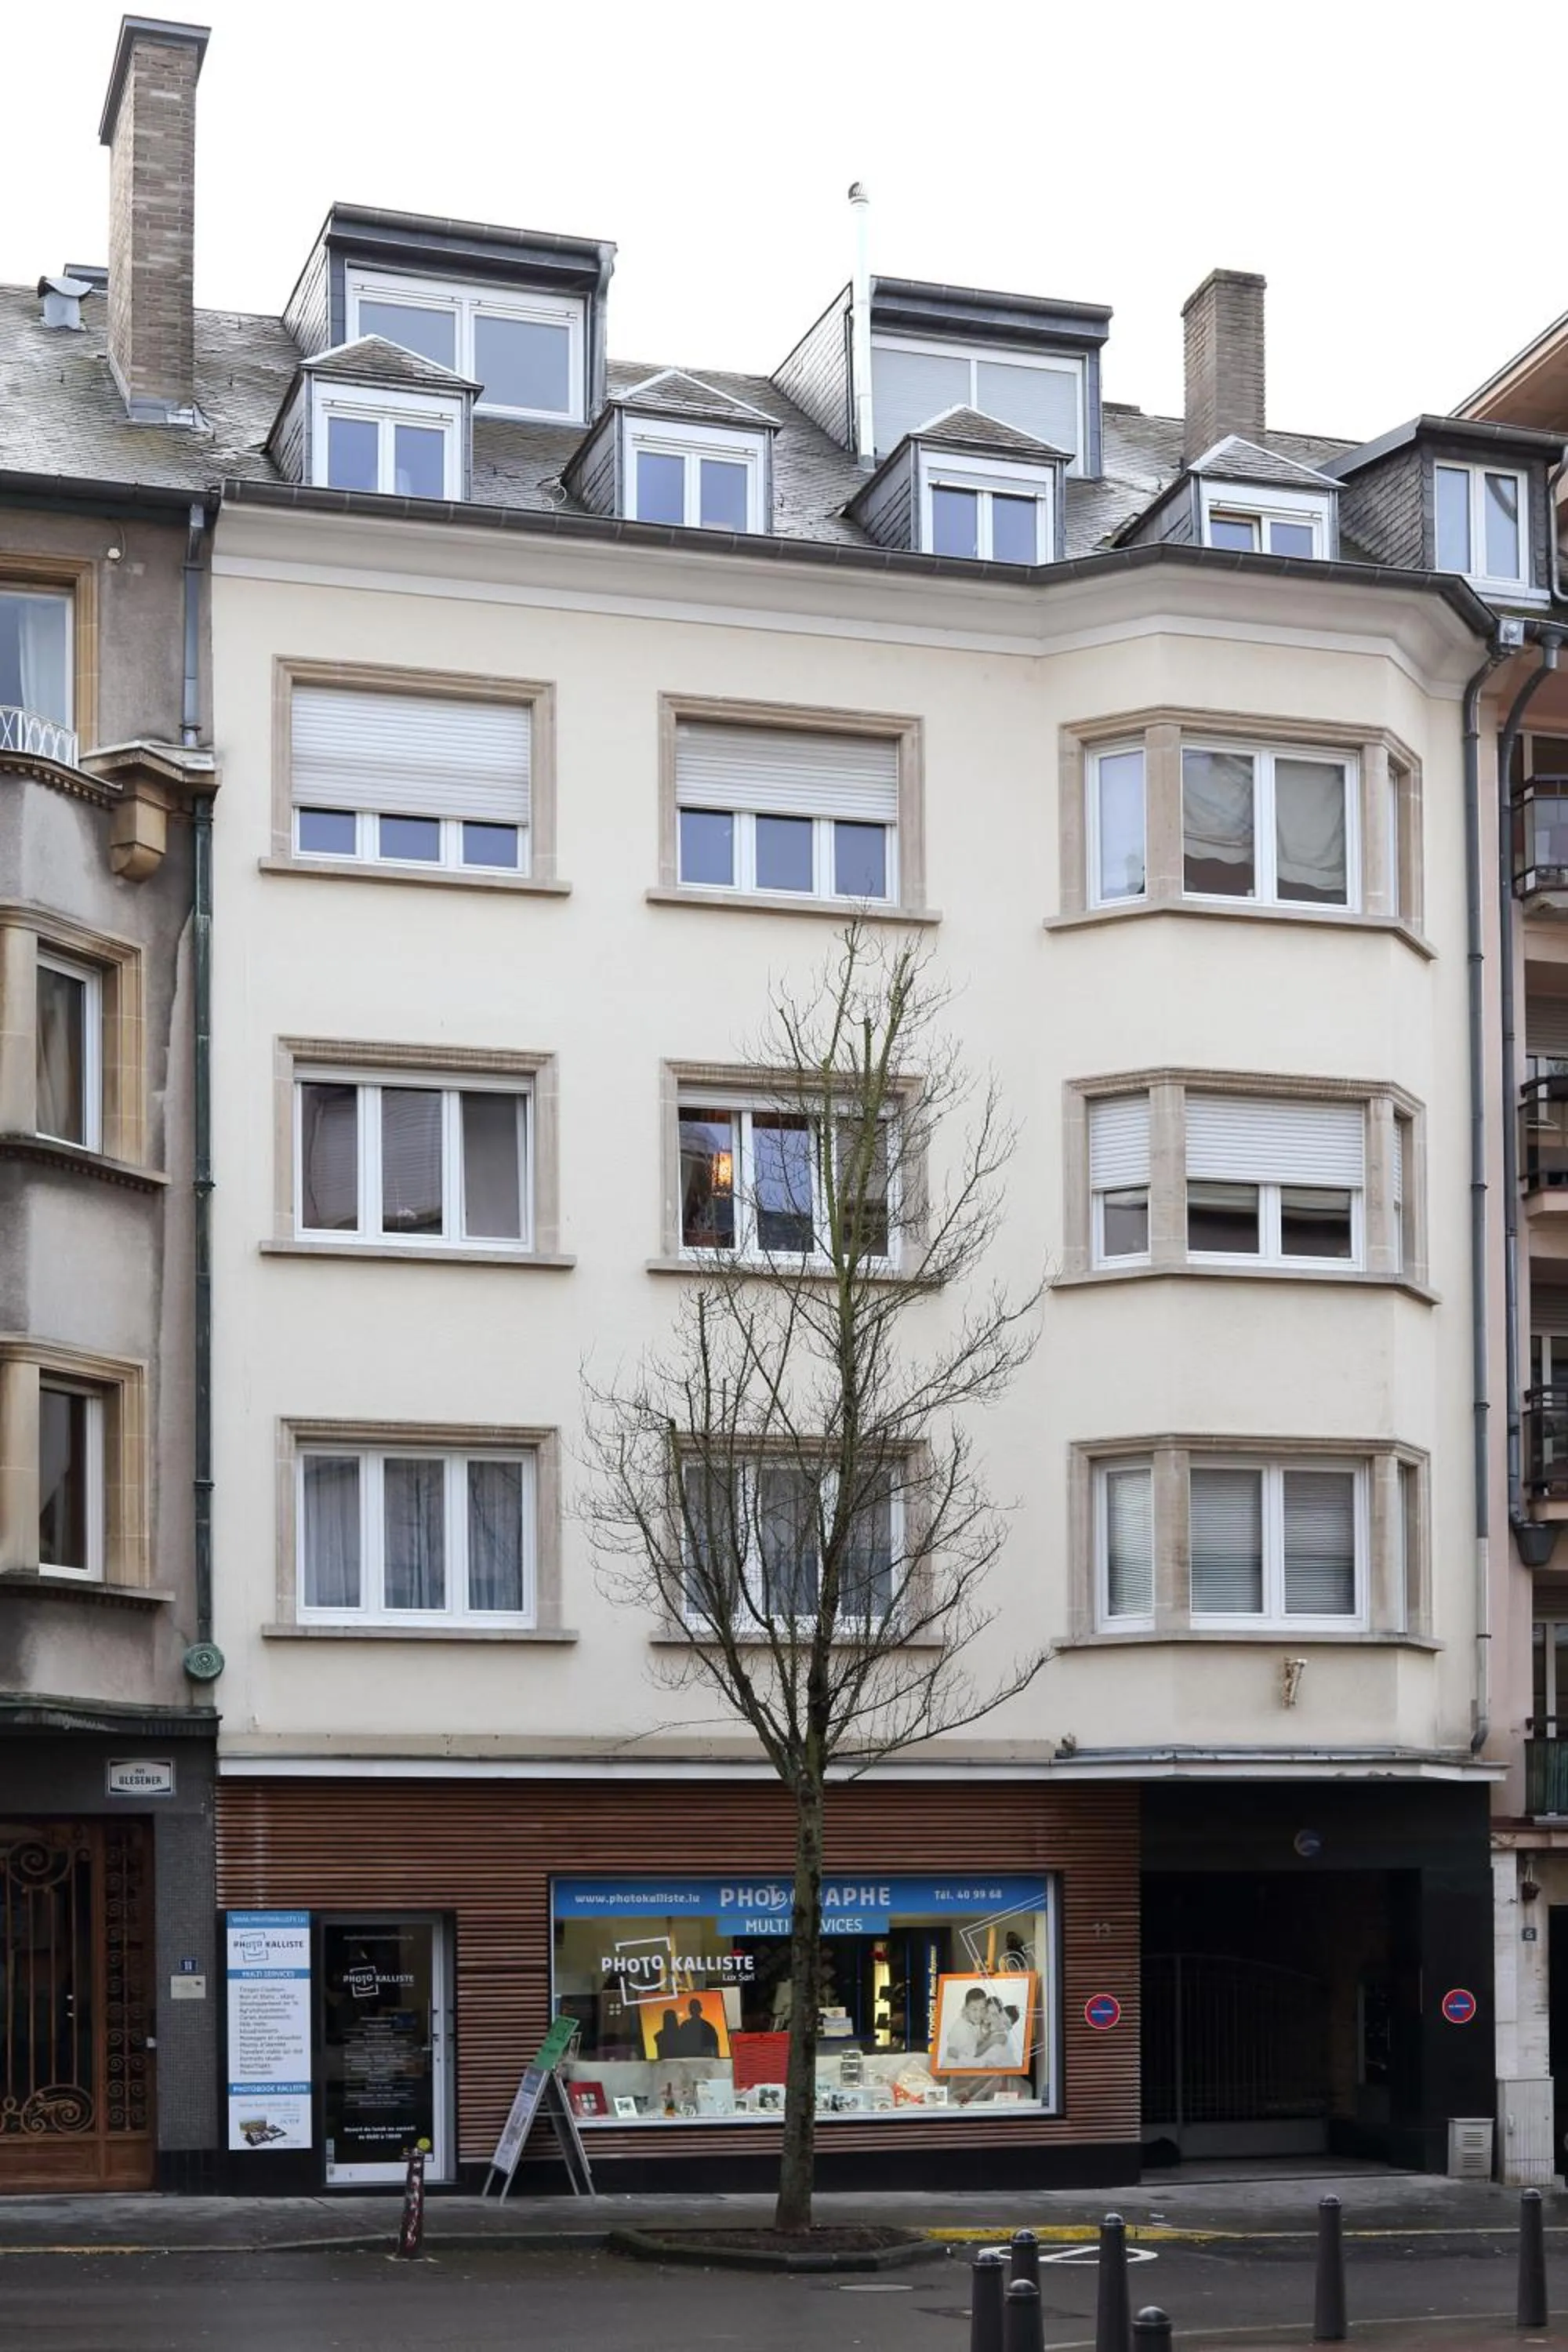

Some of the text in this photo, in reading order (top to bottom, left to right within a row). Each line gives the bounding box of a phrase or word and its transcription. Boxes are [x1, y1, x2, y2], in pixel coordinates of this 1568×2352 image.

[575, 1893, 700, 1904] www.photokalliste.lu
[720, 1885, 891, 1911] PHOTOAPHE
[957, 1889, 970, 1900] 40
[975, 1889, 985, 1900] 99
[746, 1918, 862, 1933] MULTI VICES
[1093, 1923, 1111, 1937] 13
[233, 1940, 263, 1951] PHOTO
[184, 1961, 192, 1970] 11
[601, 1955, 754, 1978] PHOTO KALLISTE
[343, 1974, 415, 1986] PHOTO KALLISTE
[927, 1999, 938, 2038] Konica
